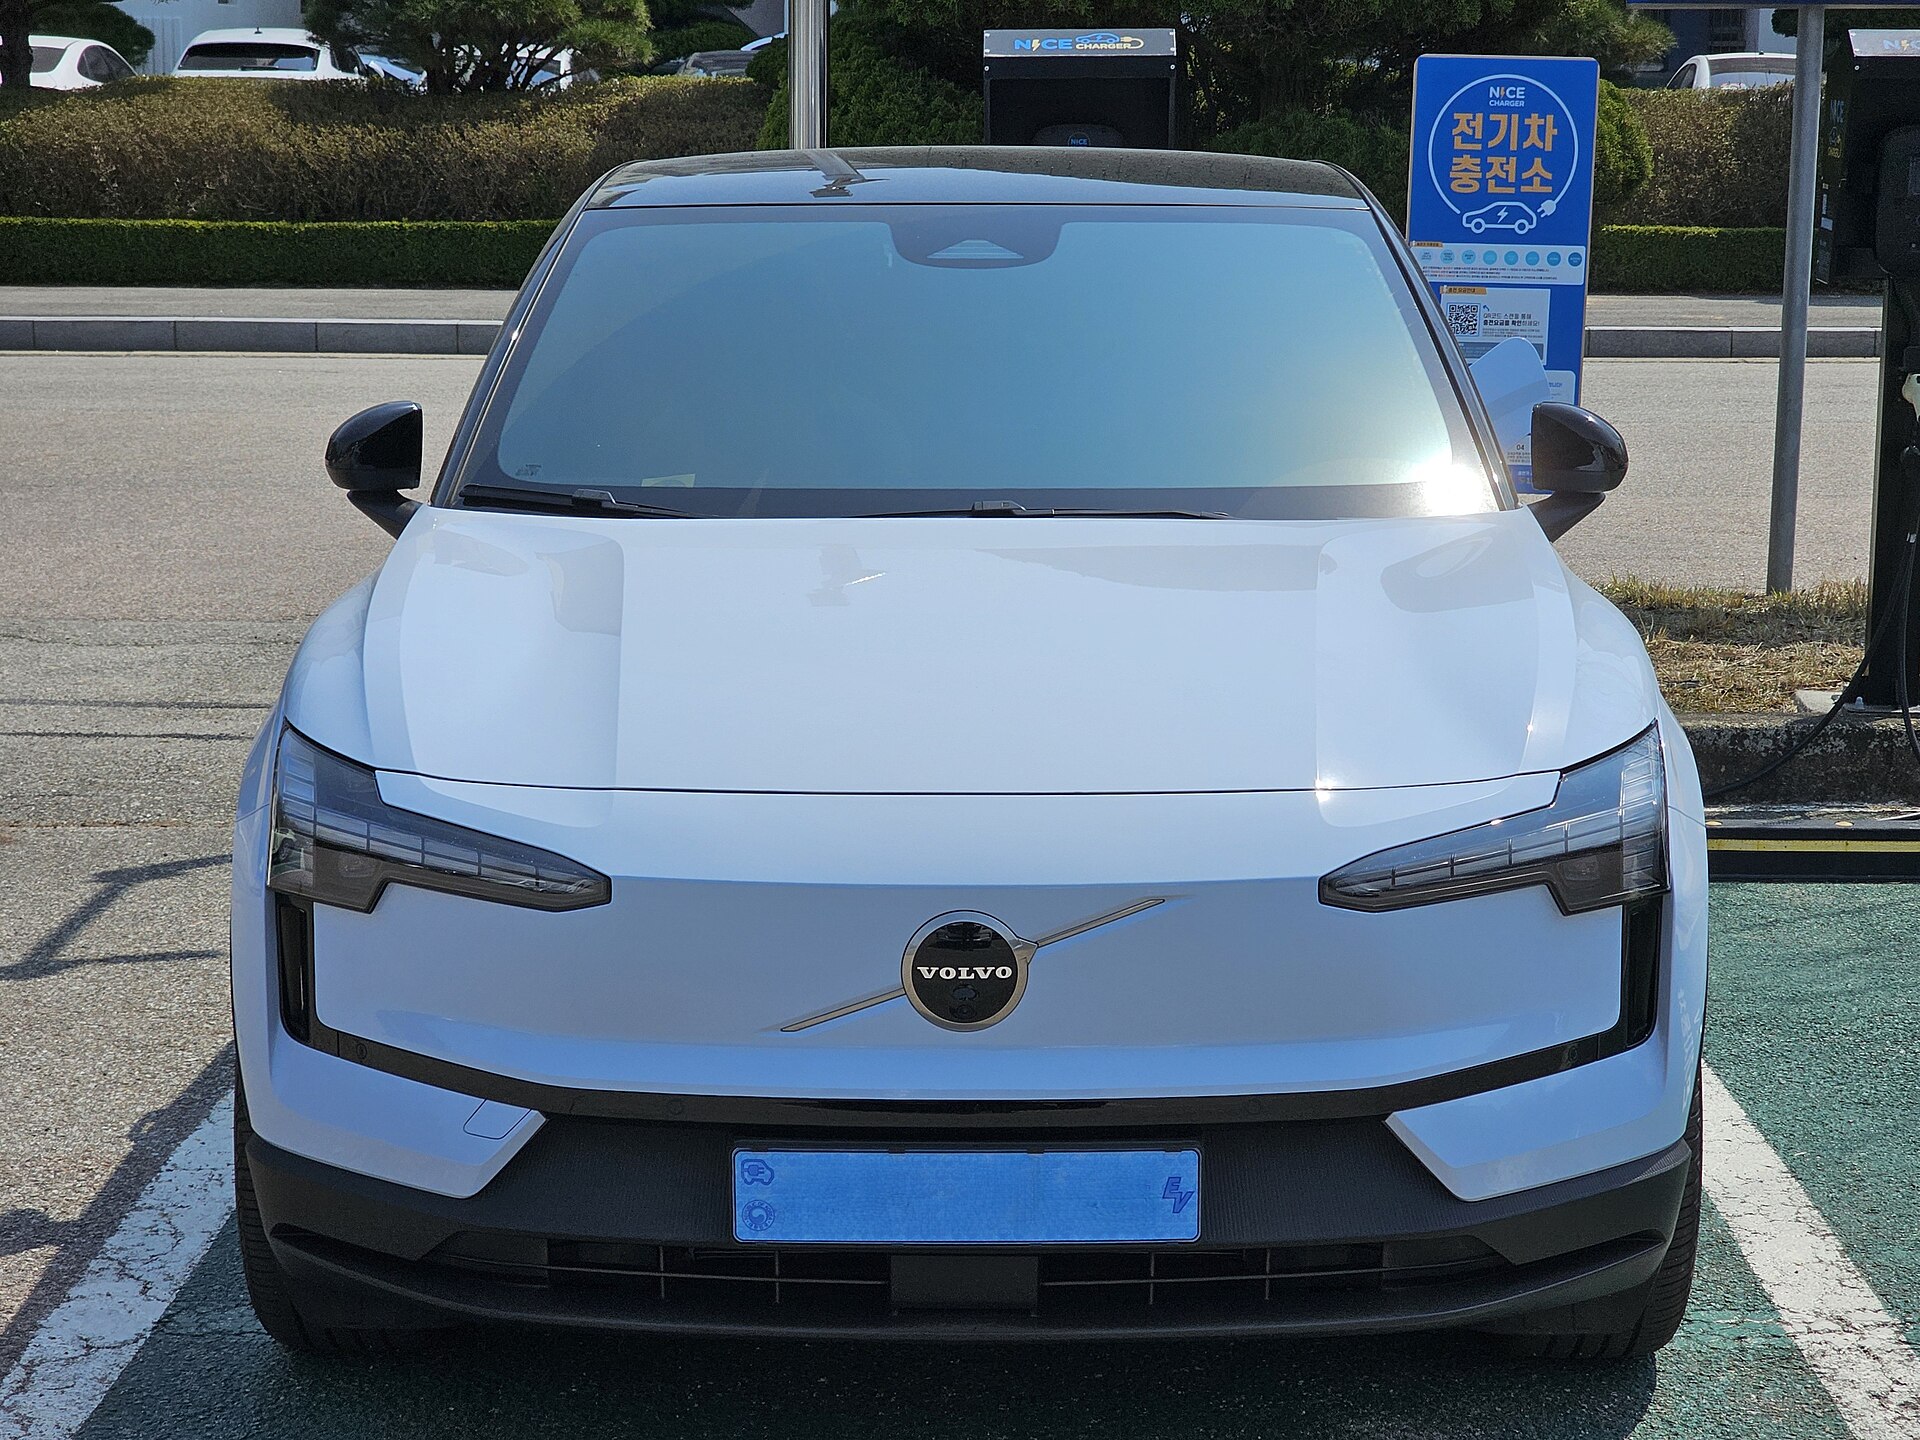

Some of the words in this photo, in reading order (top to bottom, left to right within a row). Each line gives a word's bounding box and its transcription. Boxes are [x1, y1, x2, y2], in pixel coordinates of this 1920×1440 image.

[1883, 39, 1920, 51] NIC
[1451, 112, 1558, 152] 전기차
[1449, 154, 1553, 193] 충전소
[916, 966, 1013, 980] VOLVO
[1162, 1176, 1195, 1214] EV
